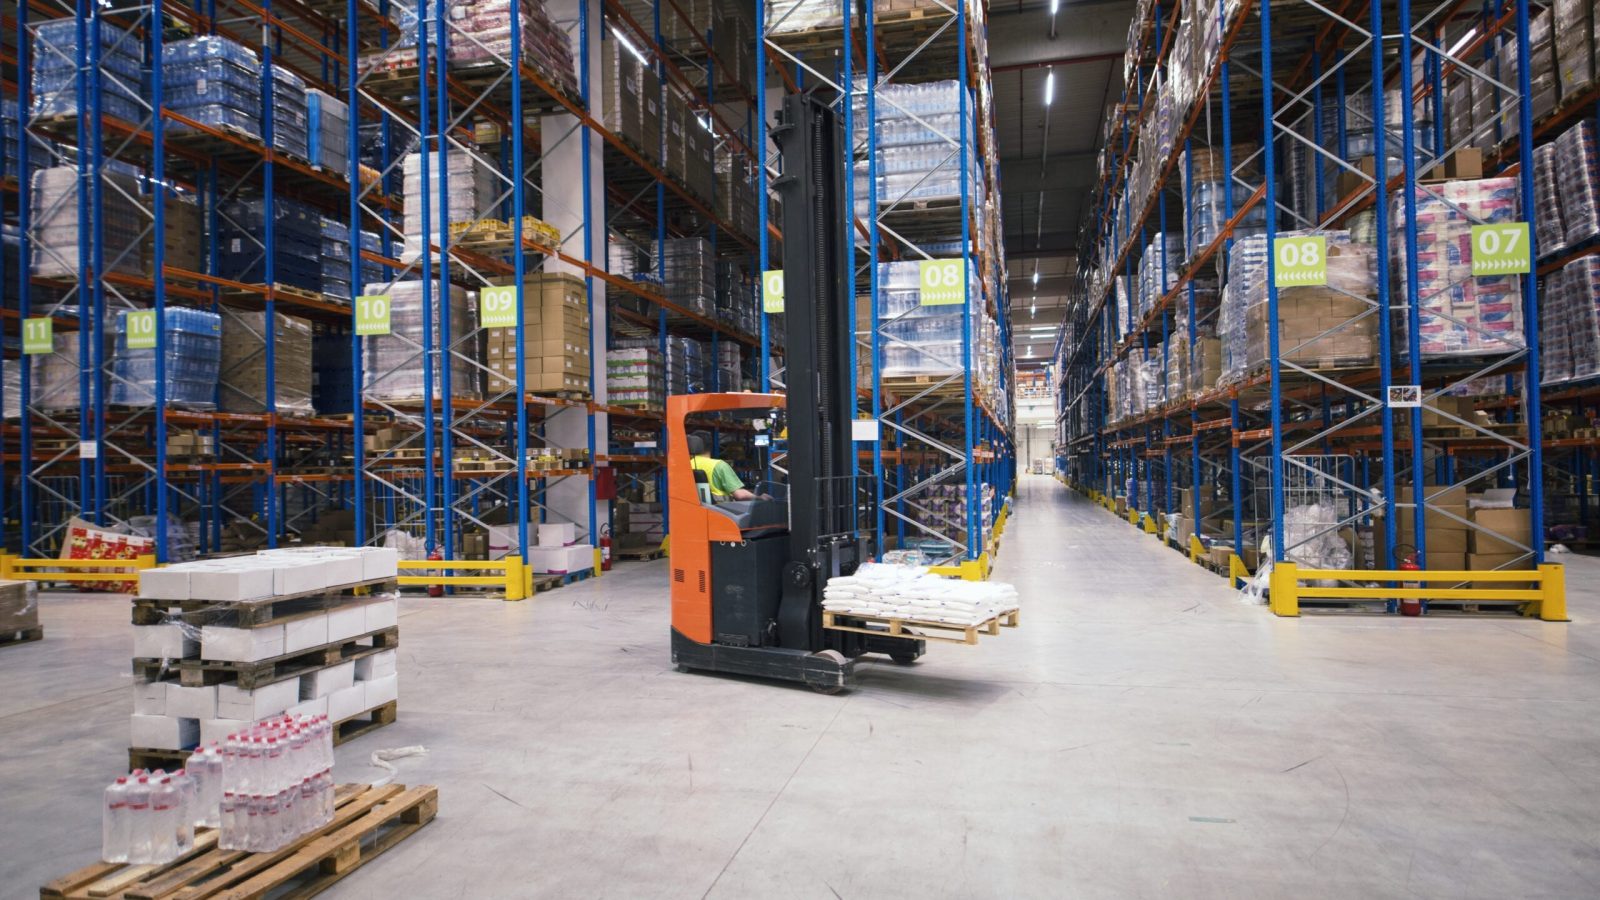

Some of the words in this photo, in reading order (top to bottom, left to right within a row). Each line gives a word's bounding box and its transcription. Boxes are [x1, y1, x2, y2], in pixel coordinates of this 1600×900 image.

[1479, 229, 1522, 254] 07
[1280, 242, 1319, 267] 08
[768, 275, 783, 295] 0
[925, 264, 960, 287] 08
[361, 299, 386, 320] 10
[485, 291, 513, 312] 09
[28, 322, 47, 340] 11
[131, 315, 154, 334] 10
